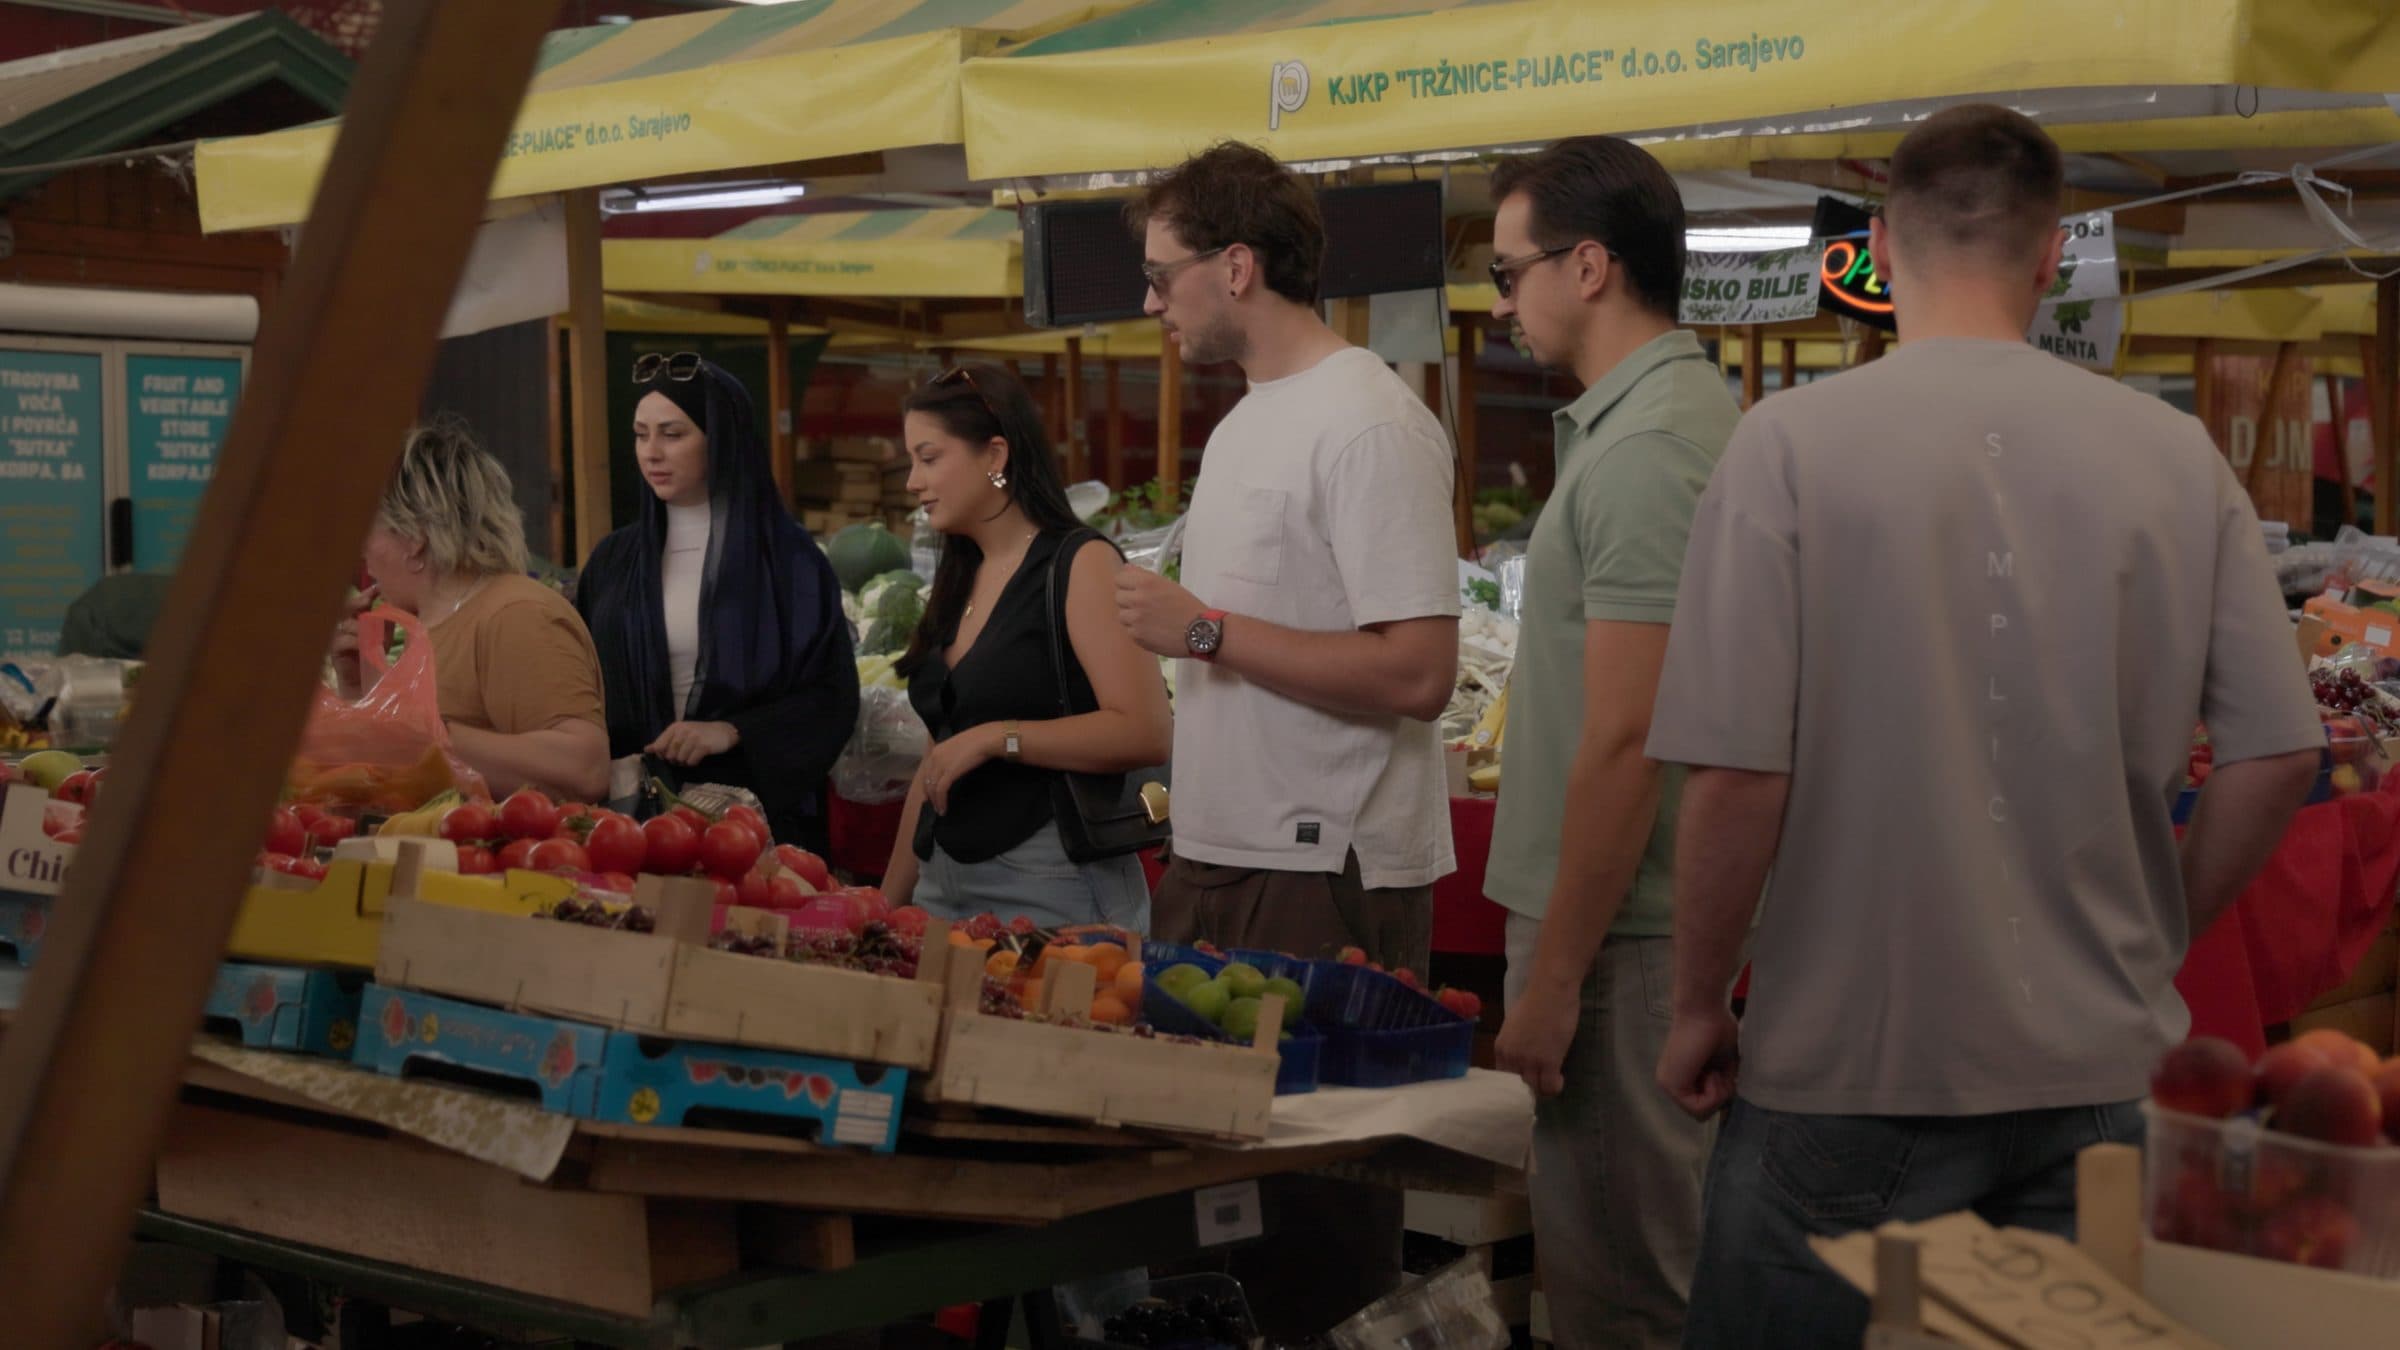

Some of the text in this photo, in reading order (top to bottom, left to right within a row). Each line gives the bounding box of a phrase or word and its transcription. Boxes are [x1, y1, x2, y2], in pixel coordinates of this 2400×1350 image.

[1328, 32, 1804, 106] KJKP "TRŽNICE-PIJACE" d.o.o. Sarajevo
[585, 120, 623, 146] d.o.o.
[628, 107, 691, 141] Sarajevo
[1746, 272, 1810, 301] BILJE
[2039, 334, 2098, 361] MENTA
[143, 375, 225, 394] FRUIT AND
[160, 420, 209, 436] STORE
